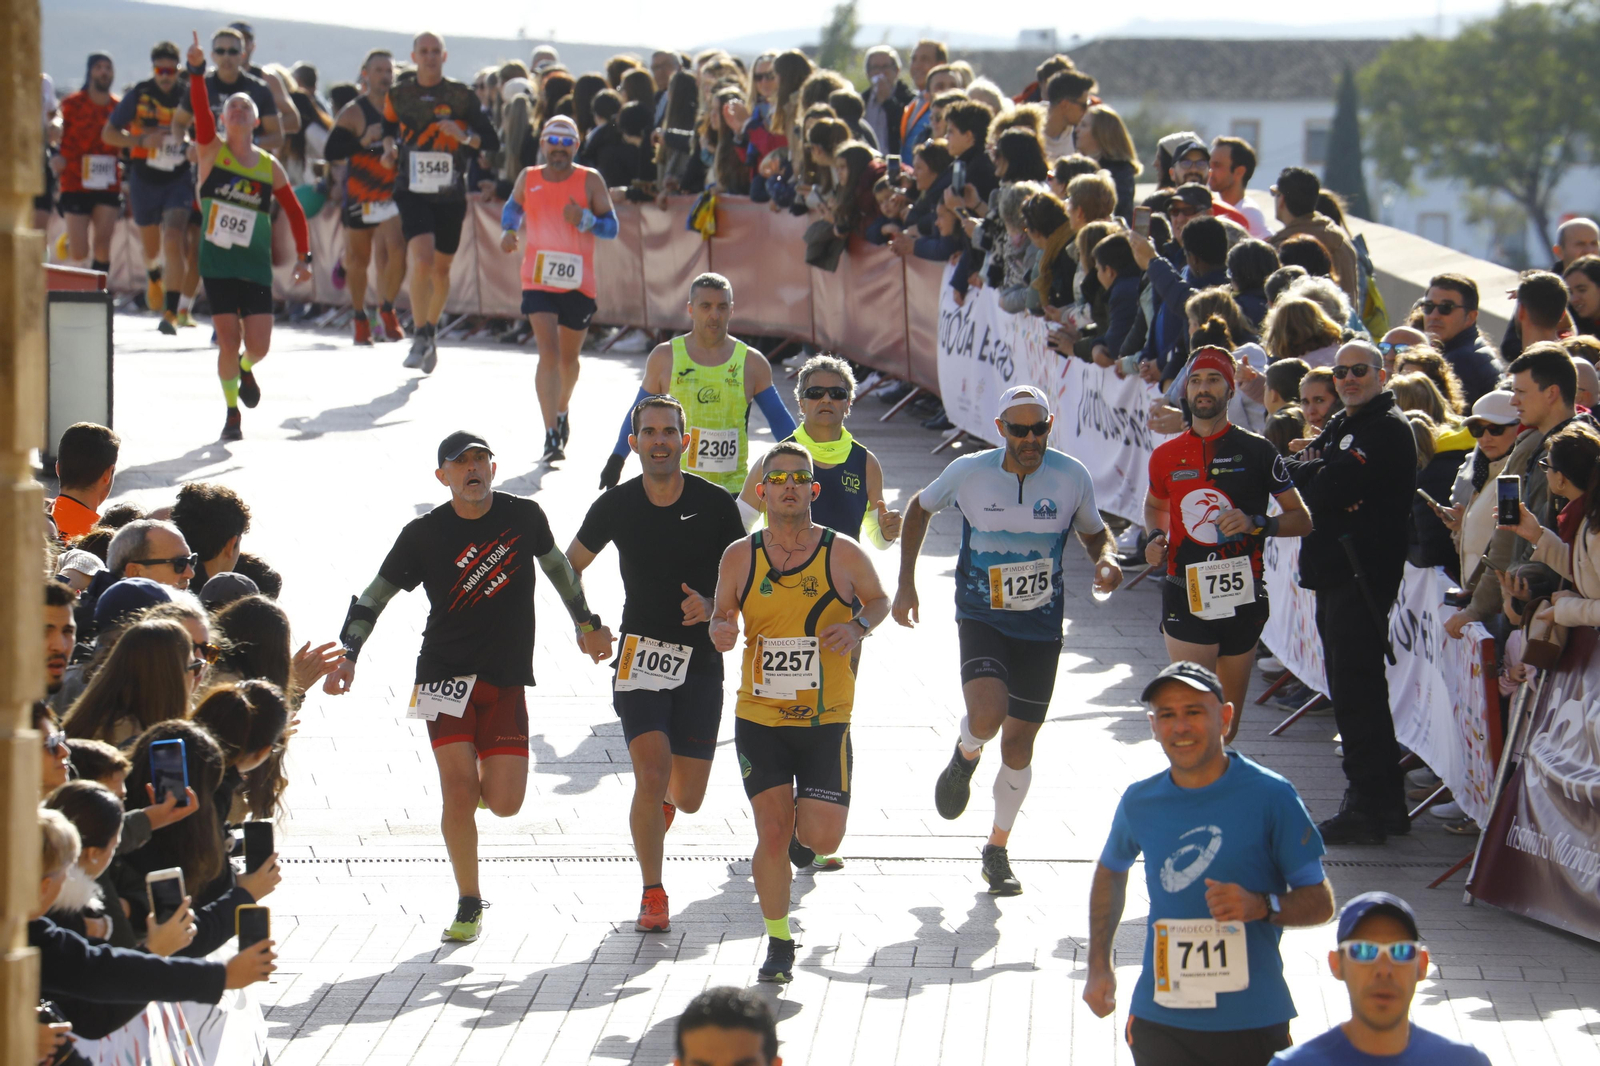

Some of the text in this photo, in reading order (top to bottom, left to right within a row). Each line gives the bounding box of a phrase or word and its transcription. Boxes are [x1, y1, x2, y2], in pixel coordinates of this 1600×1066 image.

[417, 161, 450, 174] 3548
[220, 214, 248, 233] 695
[548, 262, 576, 278] 780
[698, 439, 737, 457] 2305
[1205, 563, 1231, 571] IMDECO
[1004, 571, 1049, 596] 1275
[1190, 582, 1198, 602] CAJÓN
[1205, 571, 1245, 595] 755
[622, 652, 632, 670] CAJÓN
[636, 649, 686, 676] 1067
[762, 650, 815, 672] 2257
[809, 792, 838, 802] JACARSA
[1175, 925, 1213, 934] IMDECO
[1177, 939, 1227, 970] 711
